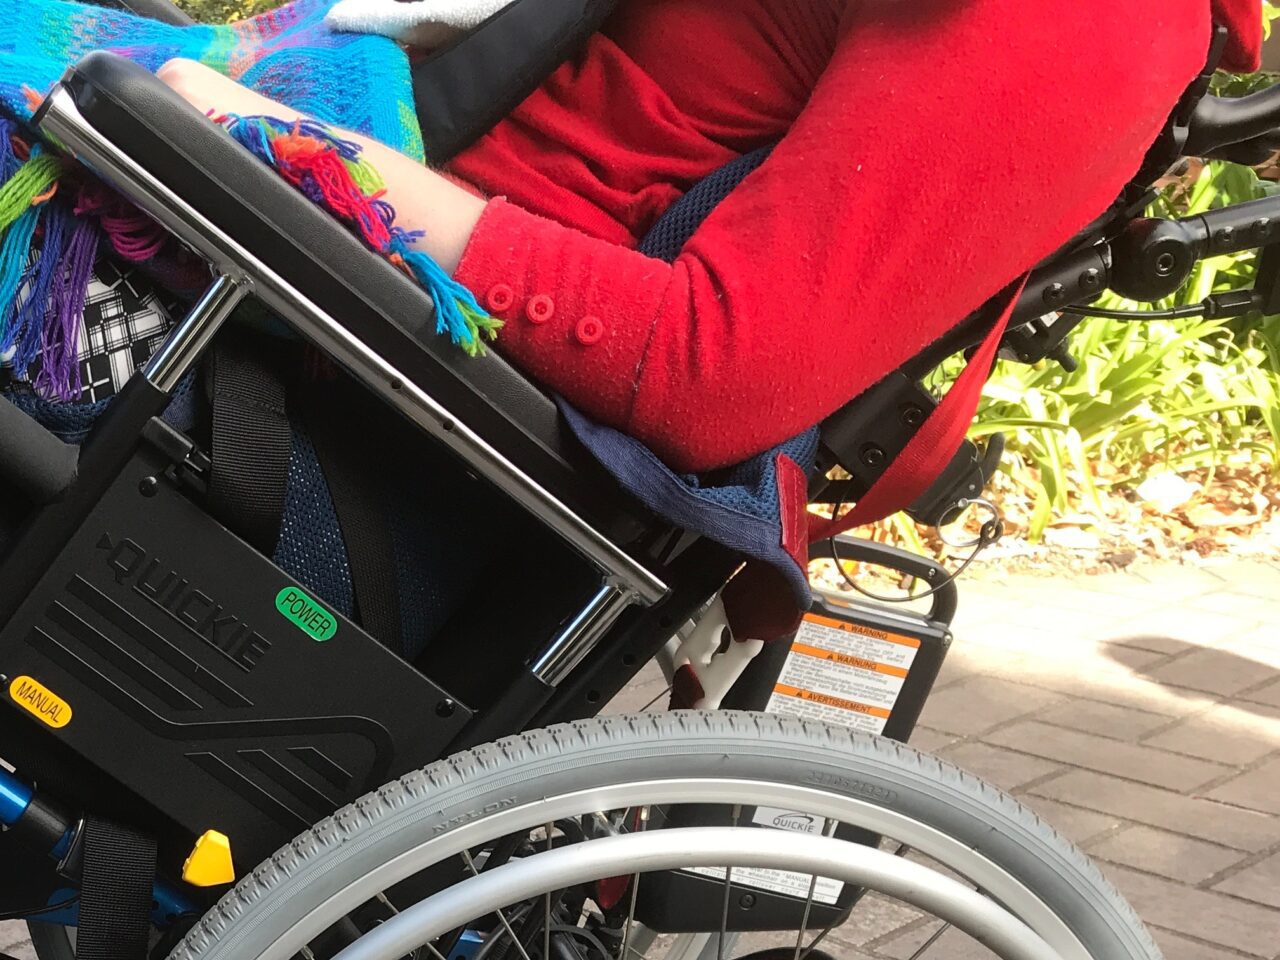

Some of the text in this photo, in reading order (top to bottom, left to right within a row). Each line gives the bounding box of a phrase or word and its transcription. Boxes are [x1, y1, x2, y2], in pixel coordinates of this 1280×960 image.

[106, 537, 272, 670] QUICKIE
[281, 591, 333, 638] POWER
[850, 624, 888, 640] WARNING
[836, 654, 877, 671] WARNUNG
[15, 681, 63, 724] MANUAL
[807, 693, 873, 713] AVERTISSEMENT
[772, 816, 816, 834] QUICKIE
